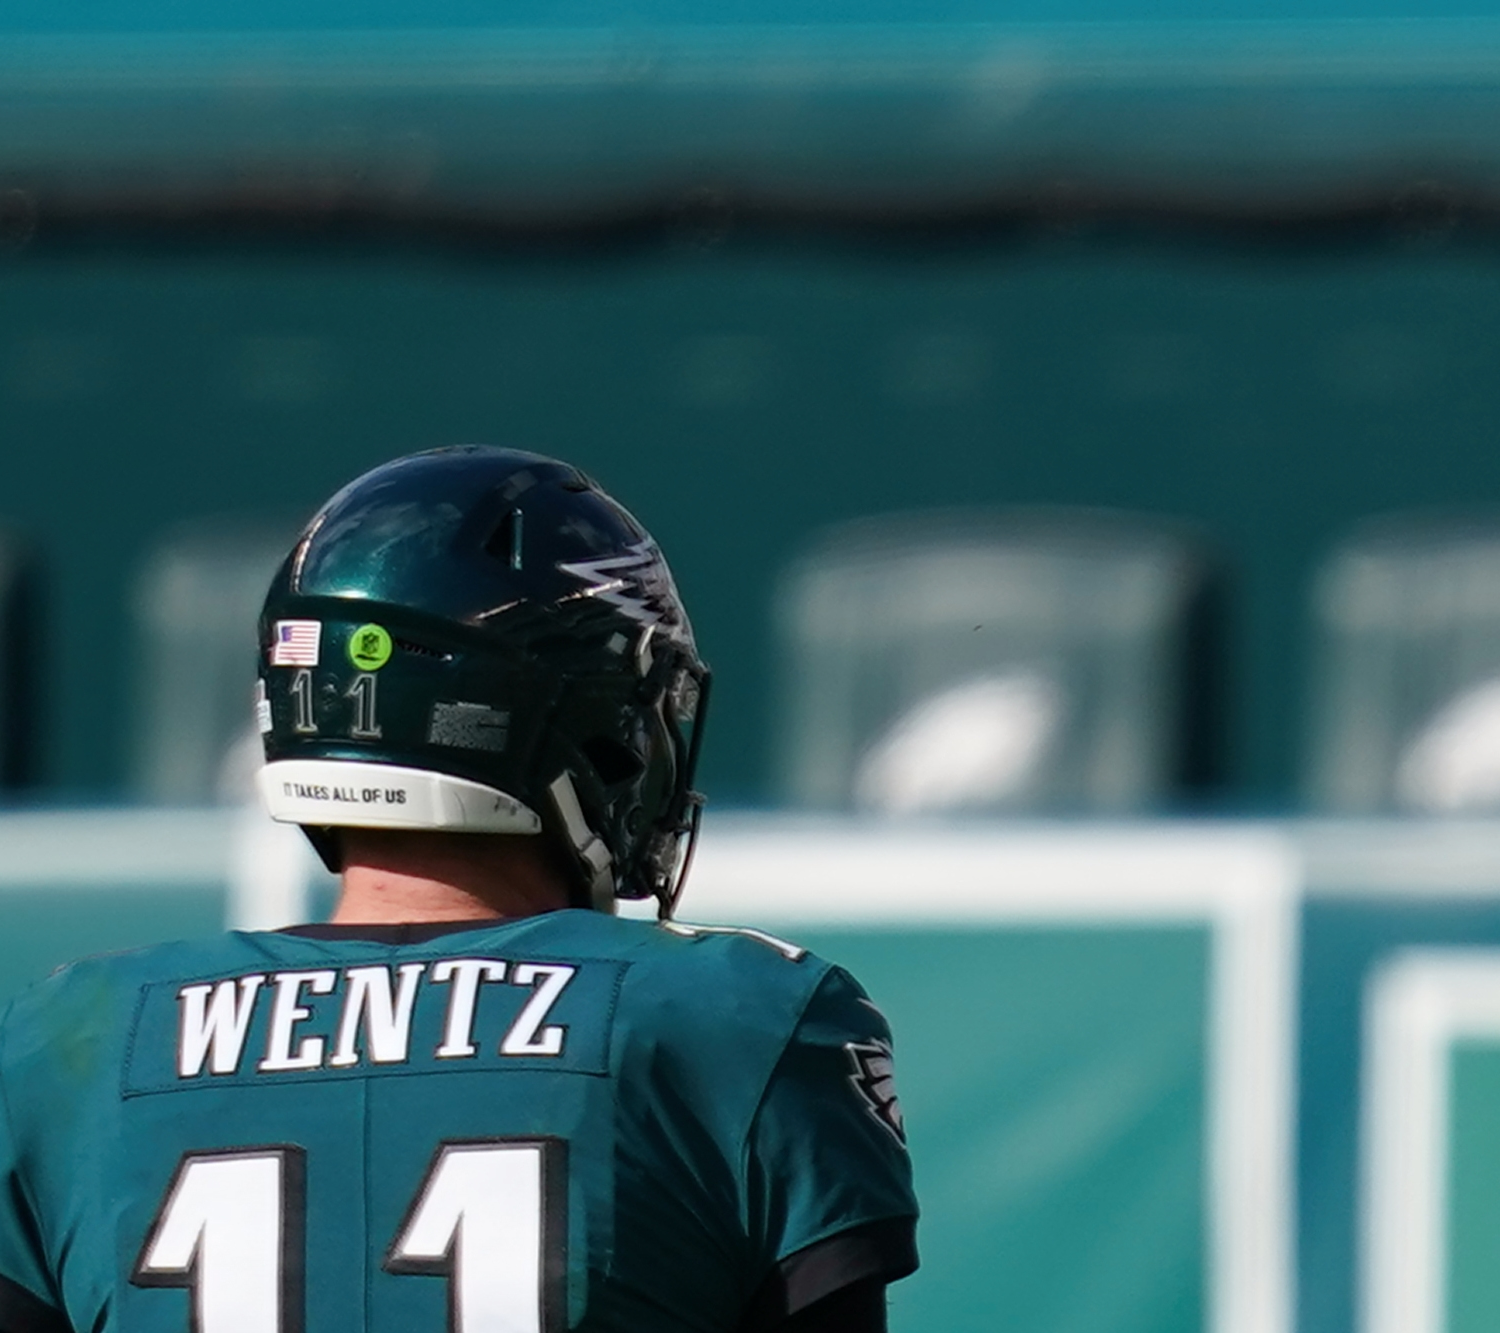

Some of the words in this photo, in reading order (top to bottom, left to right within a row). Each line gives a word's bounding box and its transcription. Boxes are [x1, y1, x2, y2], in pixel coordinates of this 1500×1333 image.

[293, 783, 330, 801] TAKES
[333, 786, 359, 803] ALL
[362, 788, 381, 804] OF
[385, 788, 406, 805] US
[175, 957, 579, 1081] WENTZ
